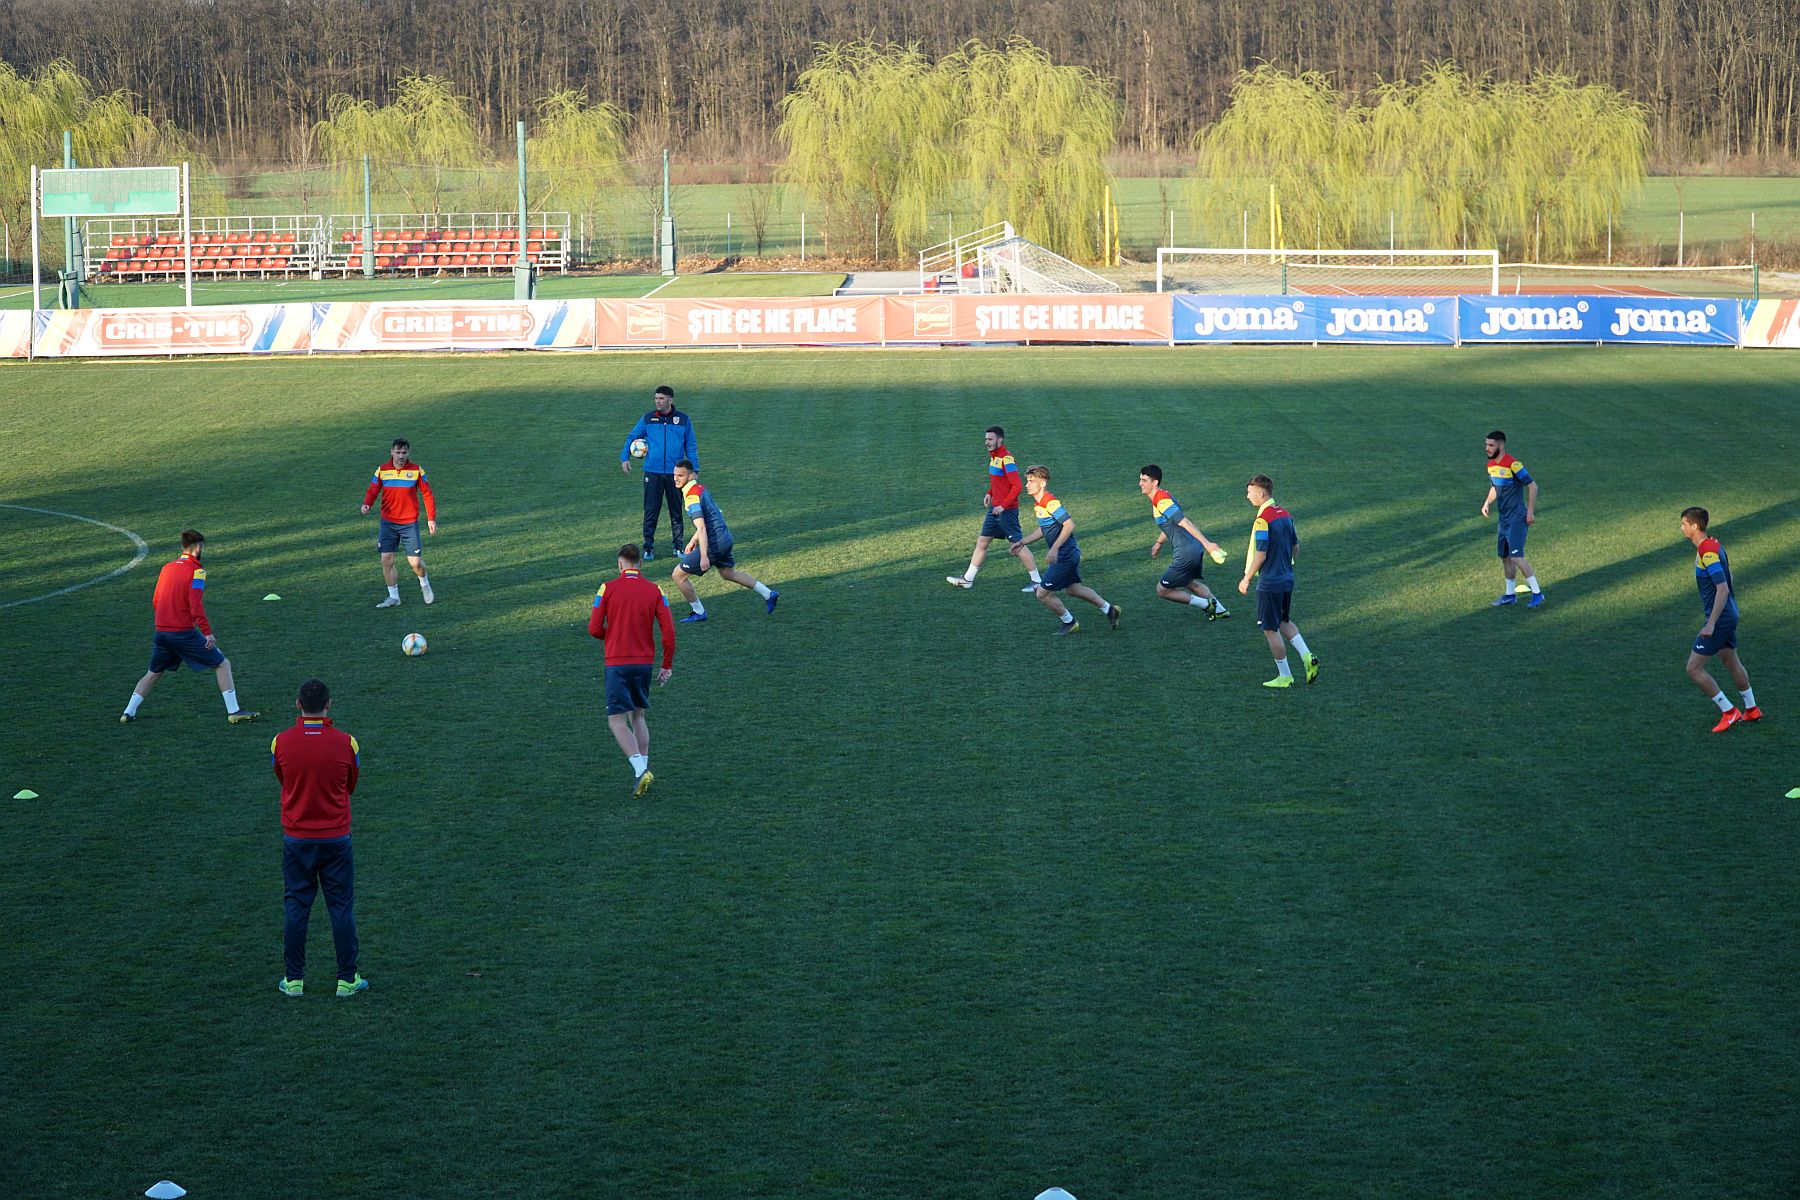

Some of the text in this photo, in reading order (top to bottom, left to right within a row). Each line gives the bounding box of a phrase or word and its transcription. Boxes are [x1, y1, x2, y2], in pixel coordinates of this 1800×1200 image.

[735, 308, 762, 334] CE
[765, 308, 791, 333] NE
[794, 307, 857, 333] PLACE
[1023, 305, 1050, 330] CE
[1053, 305, 1079, 330] NE
[1081, 305, 1145, 330] PLACE
